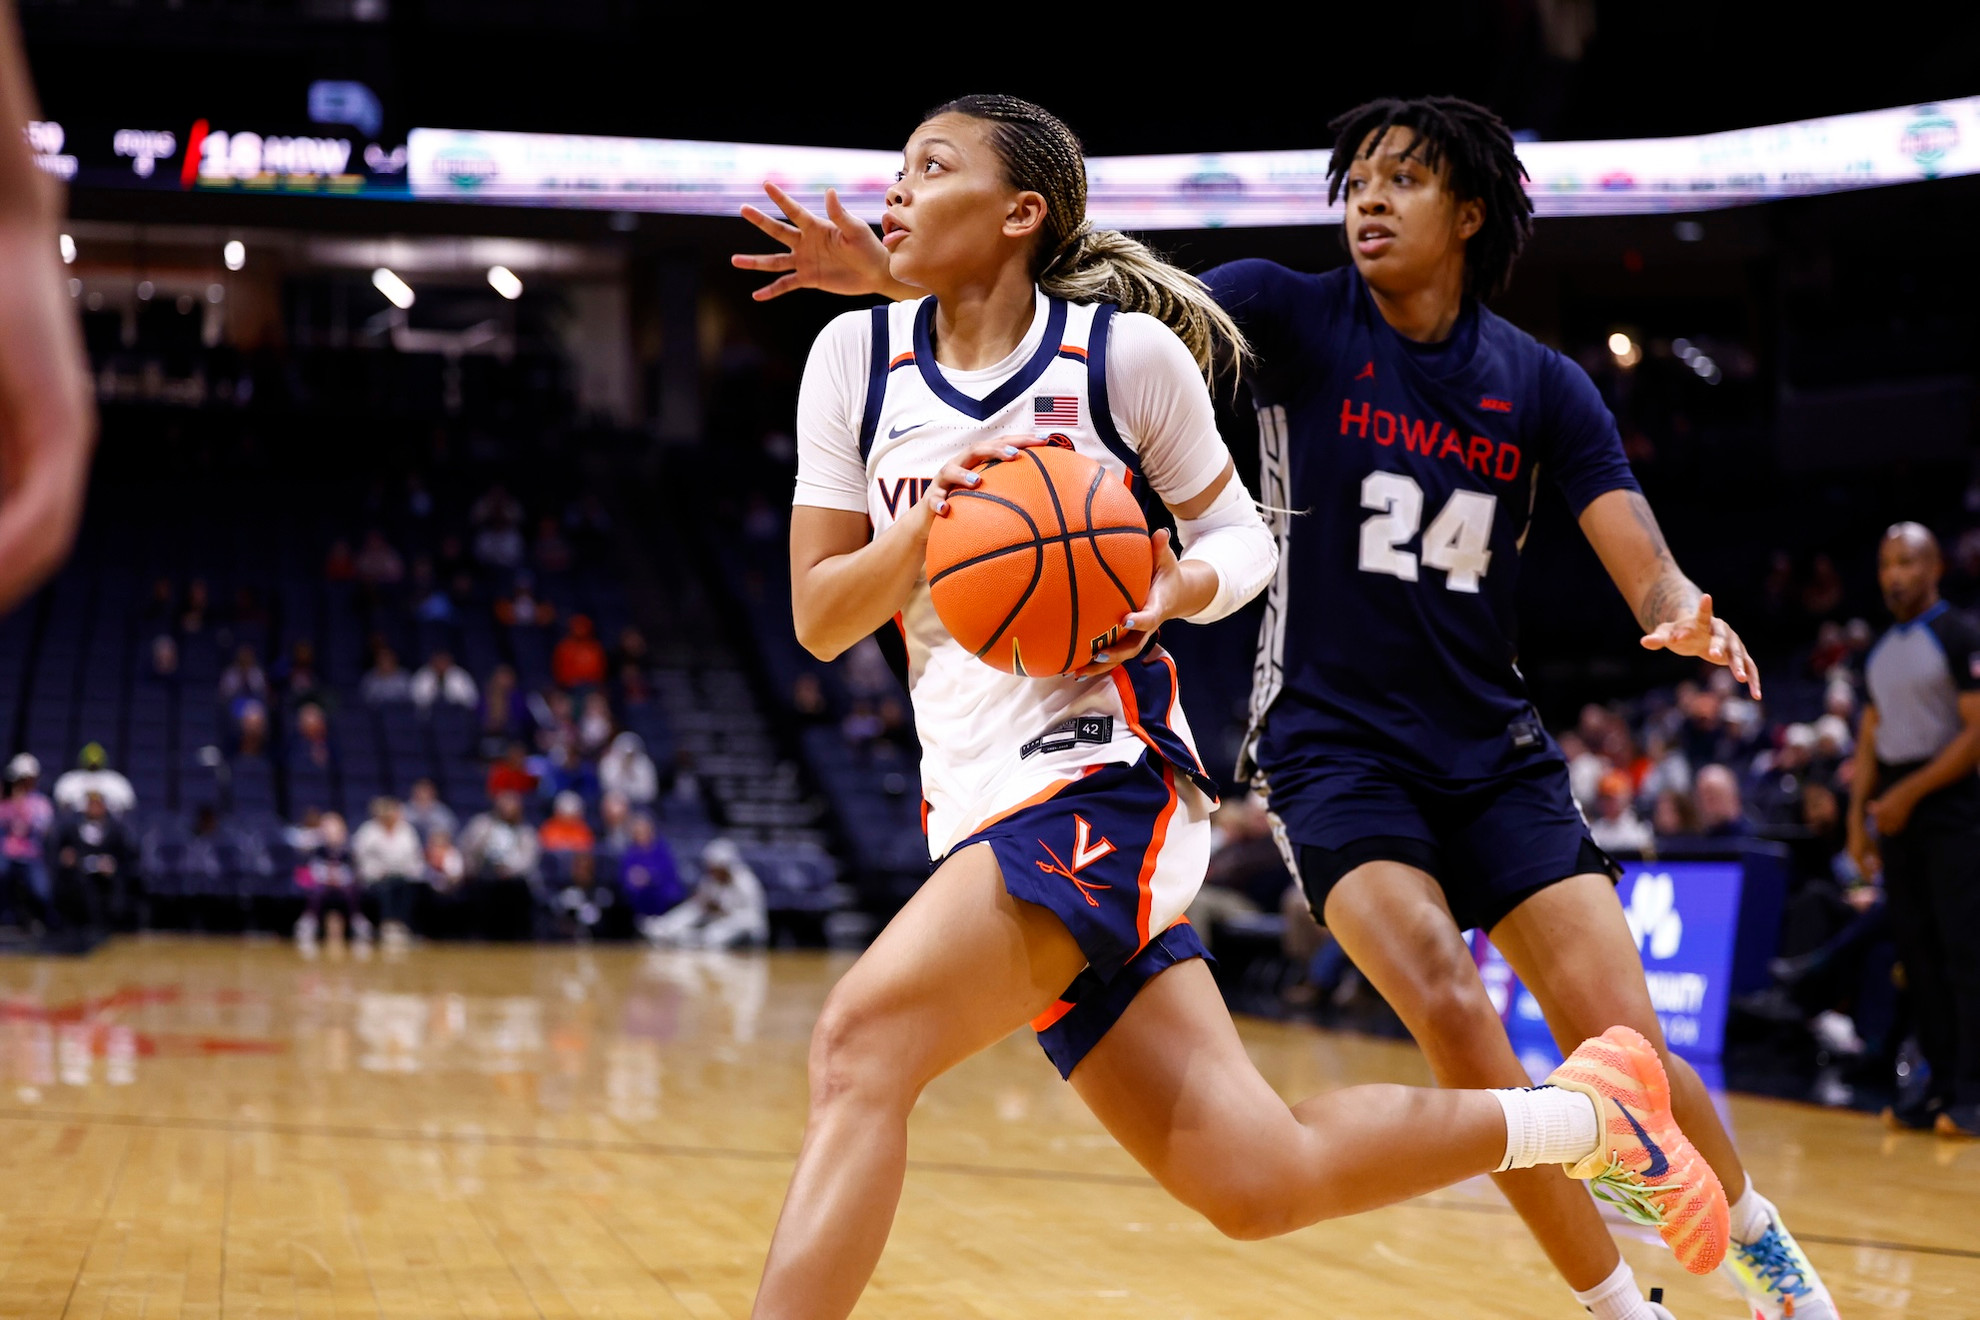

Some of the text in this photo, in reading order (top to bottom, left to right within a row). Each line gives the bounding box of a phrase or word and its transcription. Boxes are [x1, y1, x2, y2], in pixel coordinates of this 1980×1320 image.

[1340, 399, 1520, 482] HOWARD
[1358, 470, 1497, 593] 24
[1082, 723, 1099, 735] 42
